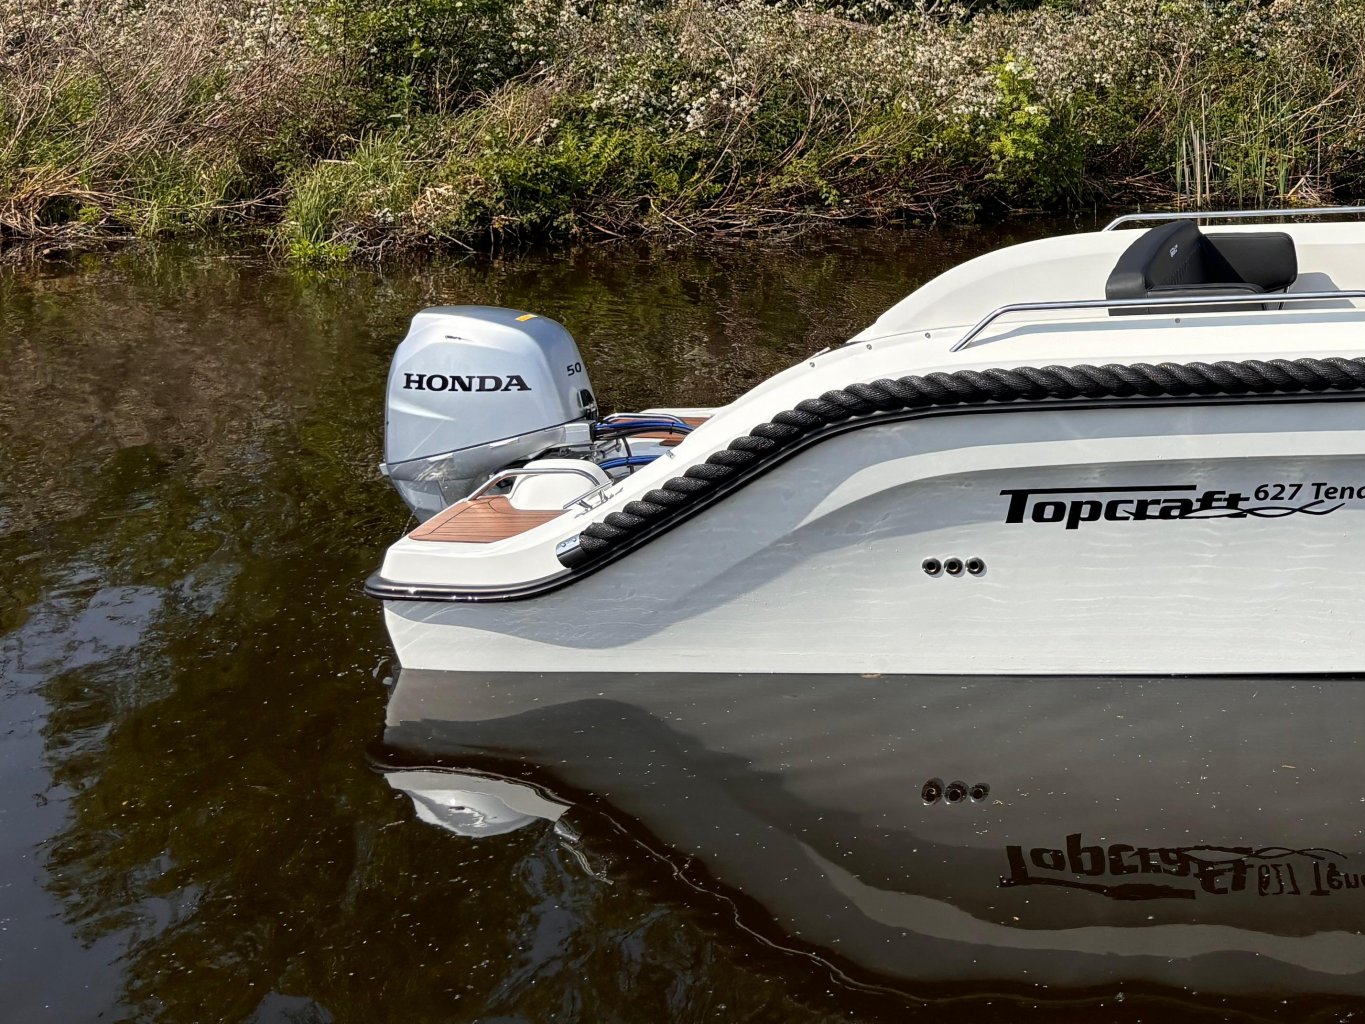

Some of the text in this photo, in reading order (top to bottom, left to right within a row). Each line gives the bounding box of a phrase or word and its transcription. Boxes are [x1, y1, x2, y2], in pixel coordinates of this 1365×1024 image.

[566, 362, 582, 377] 50
[402, 372, 532, 392] HONDA
[999, 484, 1250, 530] Topcraft
[1254, 483, 1304, 501] 627
